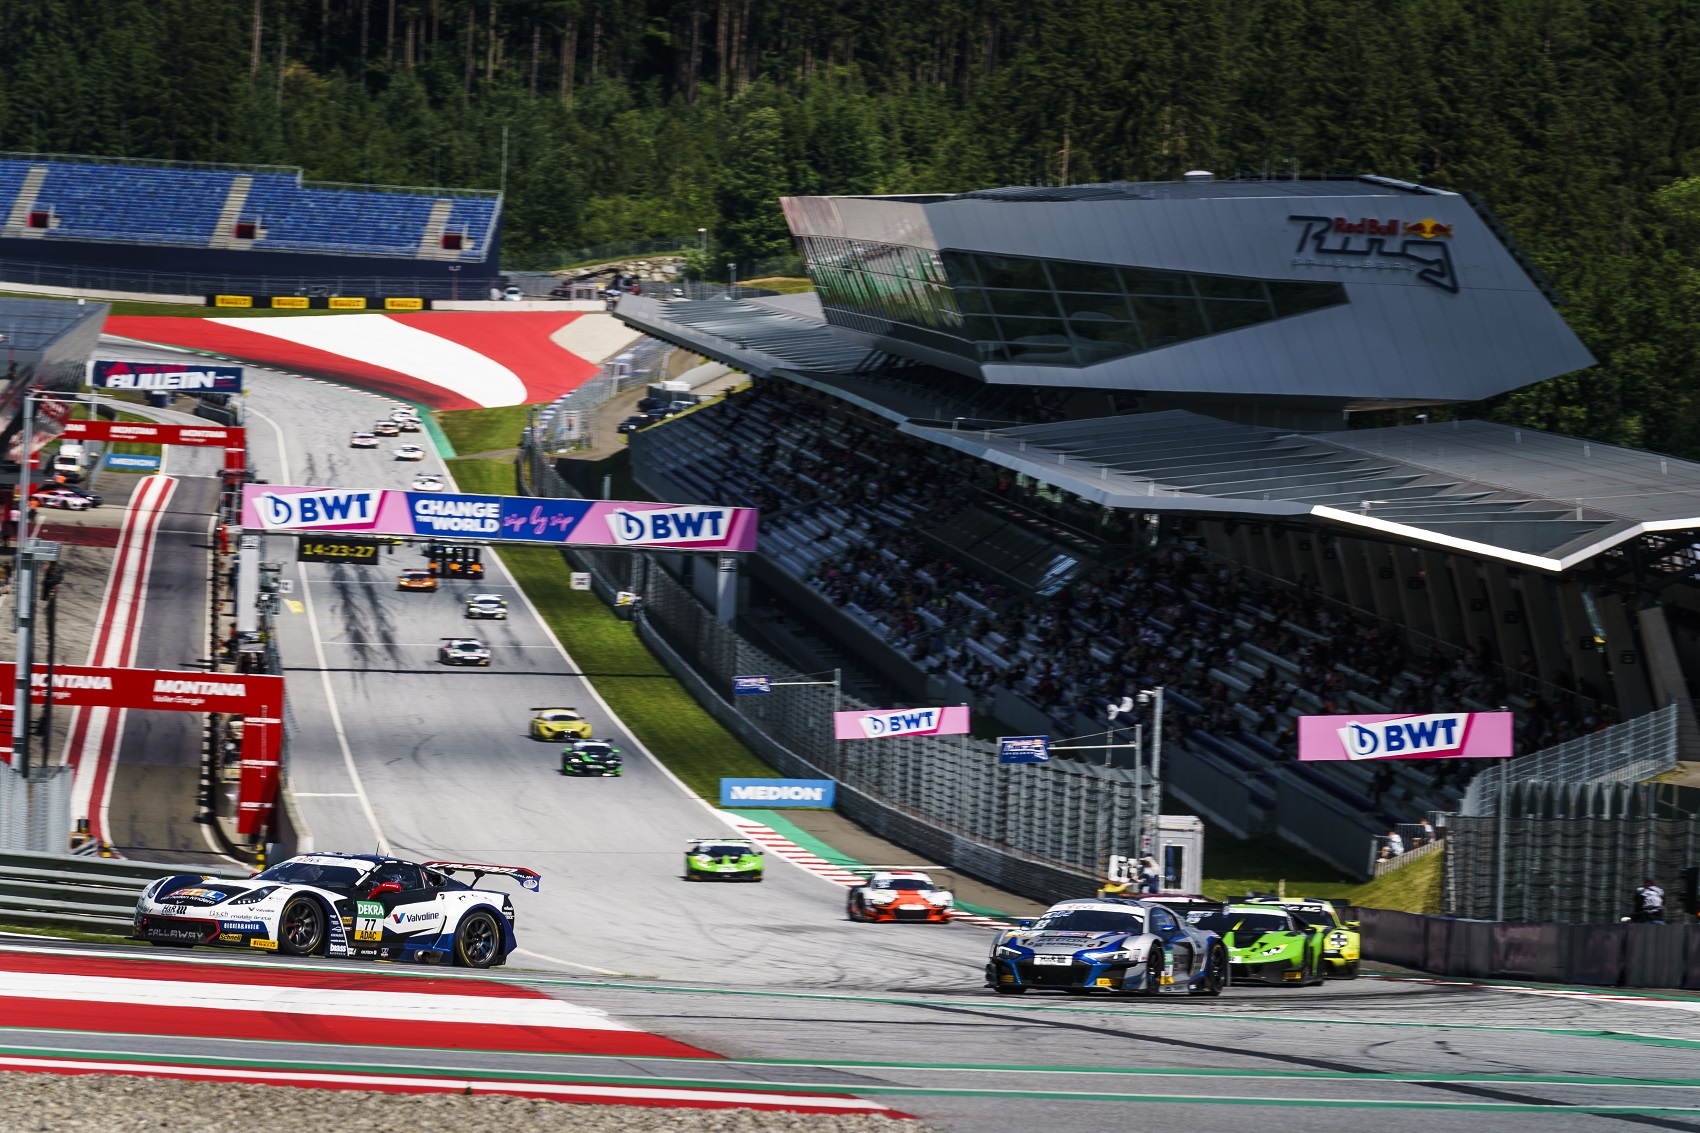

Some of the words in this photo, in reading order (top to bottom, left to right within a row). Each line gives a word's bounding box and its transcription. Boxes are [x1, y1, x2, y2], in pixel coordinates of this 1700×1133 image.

[1334, 217, 1367, 234] Red
[1368, 218, 1399, 236] Bull
[299, 493, 370, 522] BWT
[414, 499, 500, 518] CHANGE
[432, 517, 500, 533] WORLD
[503, 513, 528, 533] sip
[529, 505, 549, 535] by
[549, 512, 575, 532] sip
[651, 511, 723, 539] BWT
[303, 543, 375, 558] 14:23:27
[153, 679, 246, 697] MONTANA
[889, 711, 934, 732] BWT
[1384, 718, 1457, 752] BWT
[730, 785, 823, 801] MEDION
[357, 903, 384, 916] DEKRA
[406, 911, 440, 923] Valvoline
[364, 918, 377, 931] 77
[359, 930, 377, 941] ADAC
